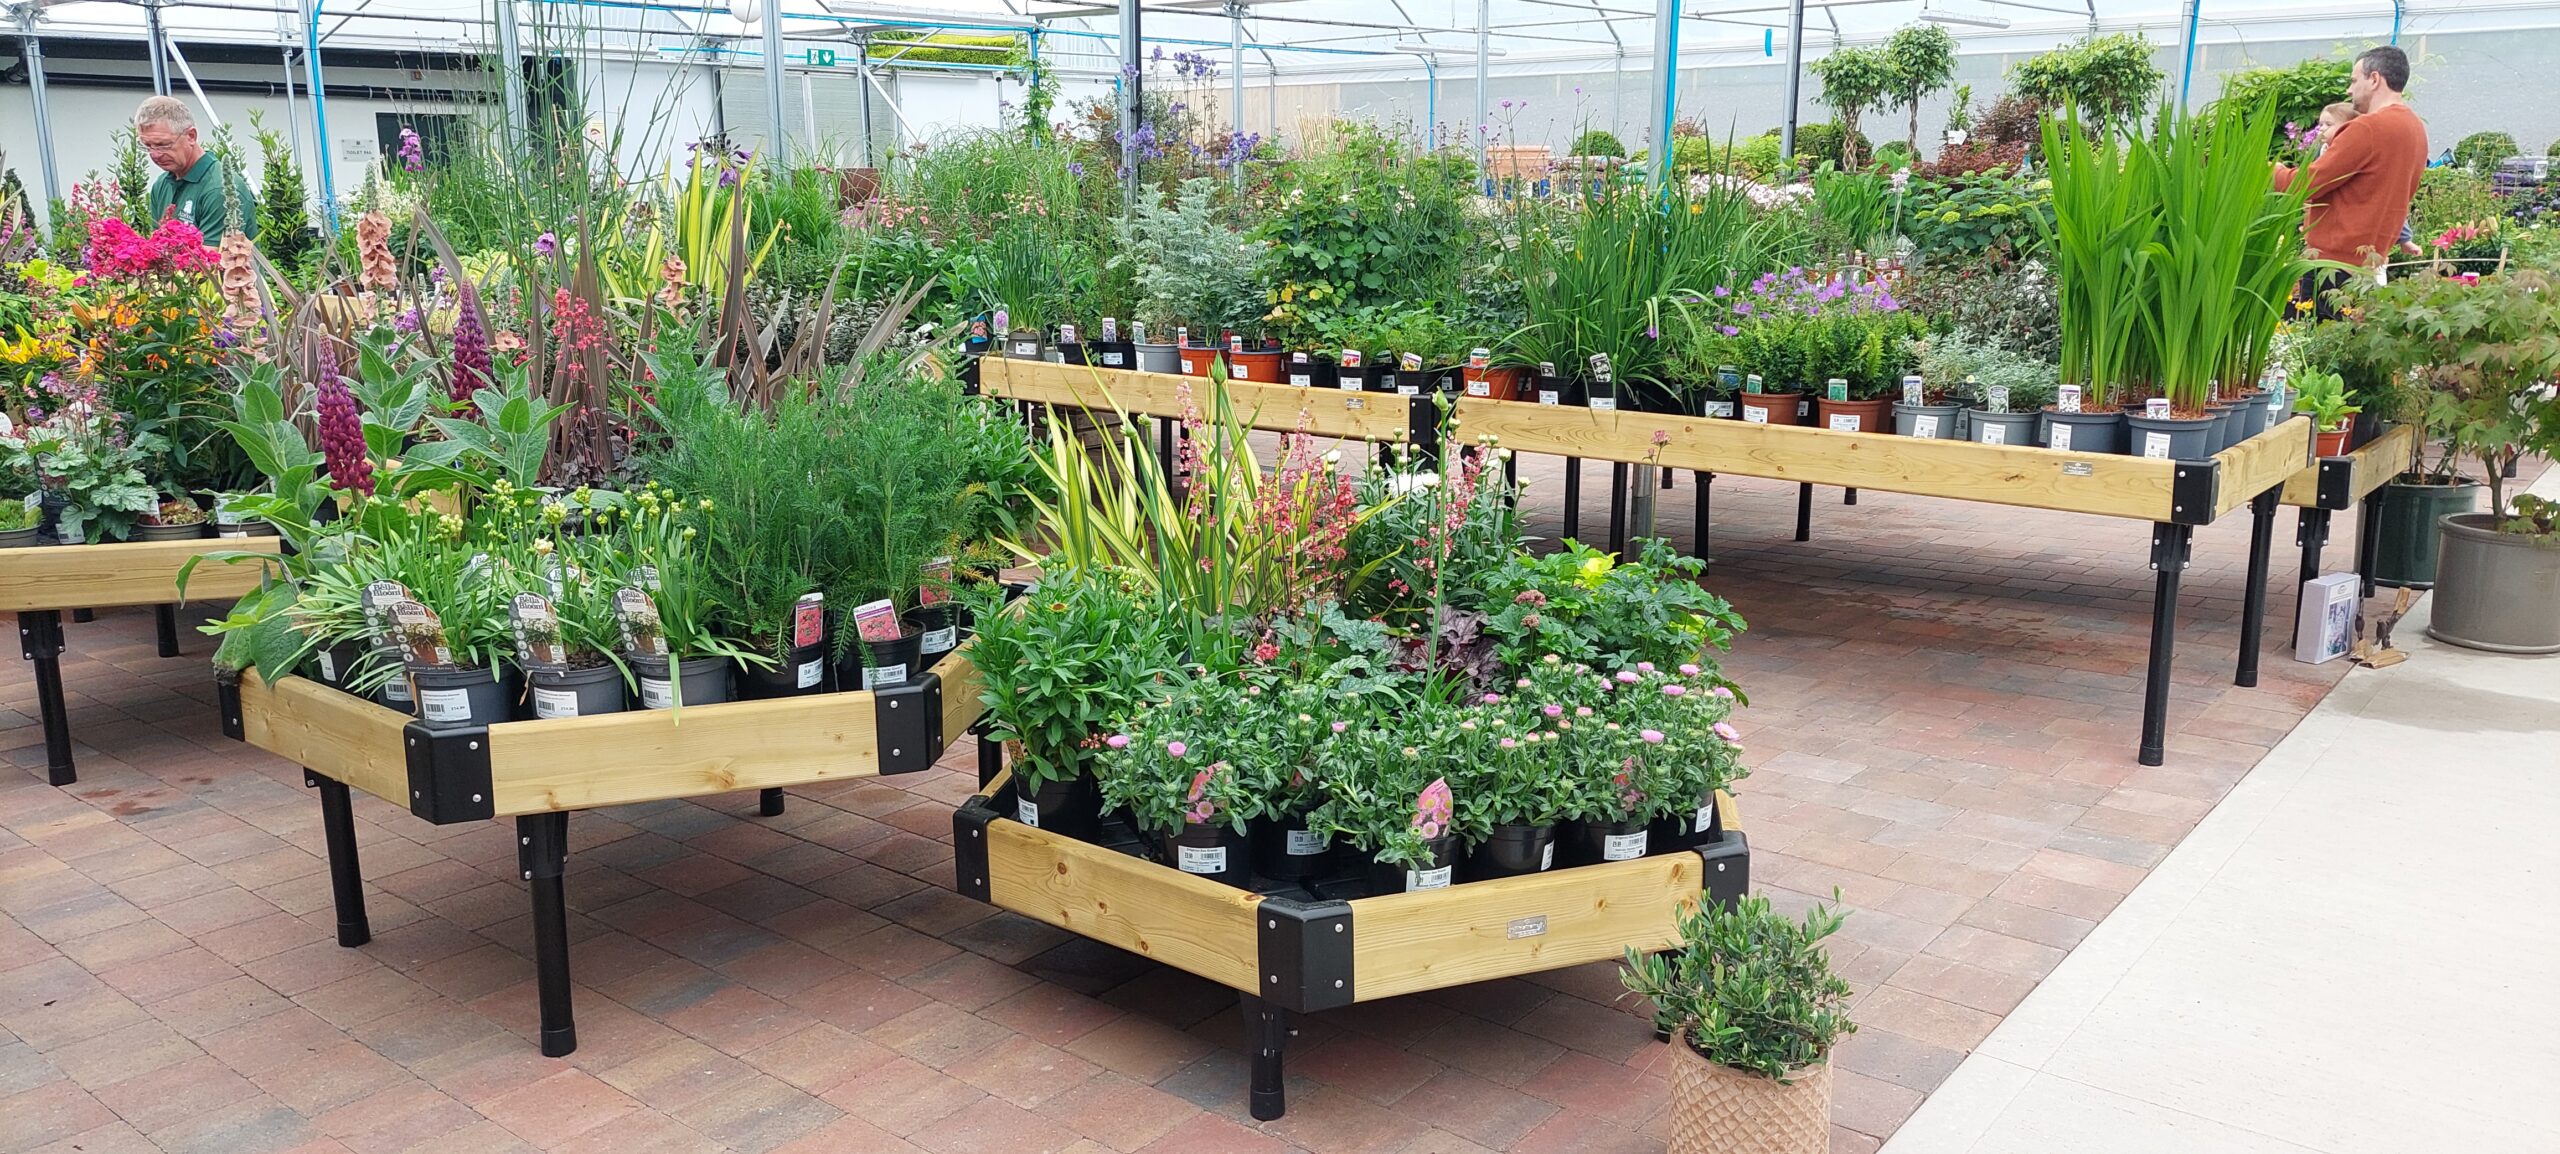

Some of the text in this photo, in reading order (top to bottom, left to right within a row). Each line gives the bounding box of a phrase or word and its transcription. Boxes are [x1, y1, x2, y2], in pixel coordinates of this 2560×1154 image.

[373, 589, 402, 597] Bloom
[621, 596, 645, 604] Bloom
[519, 602, 544, 610] Bloom
